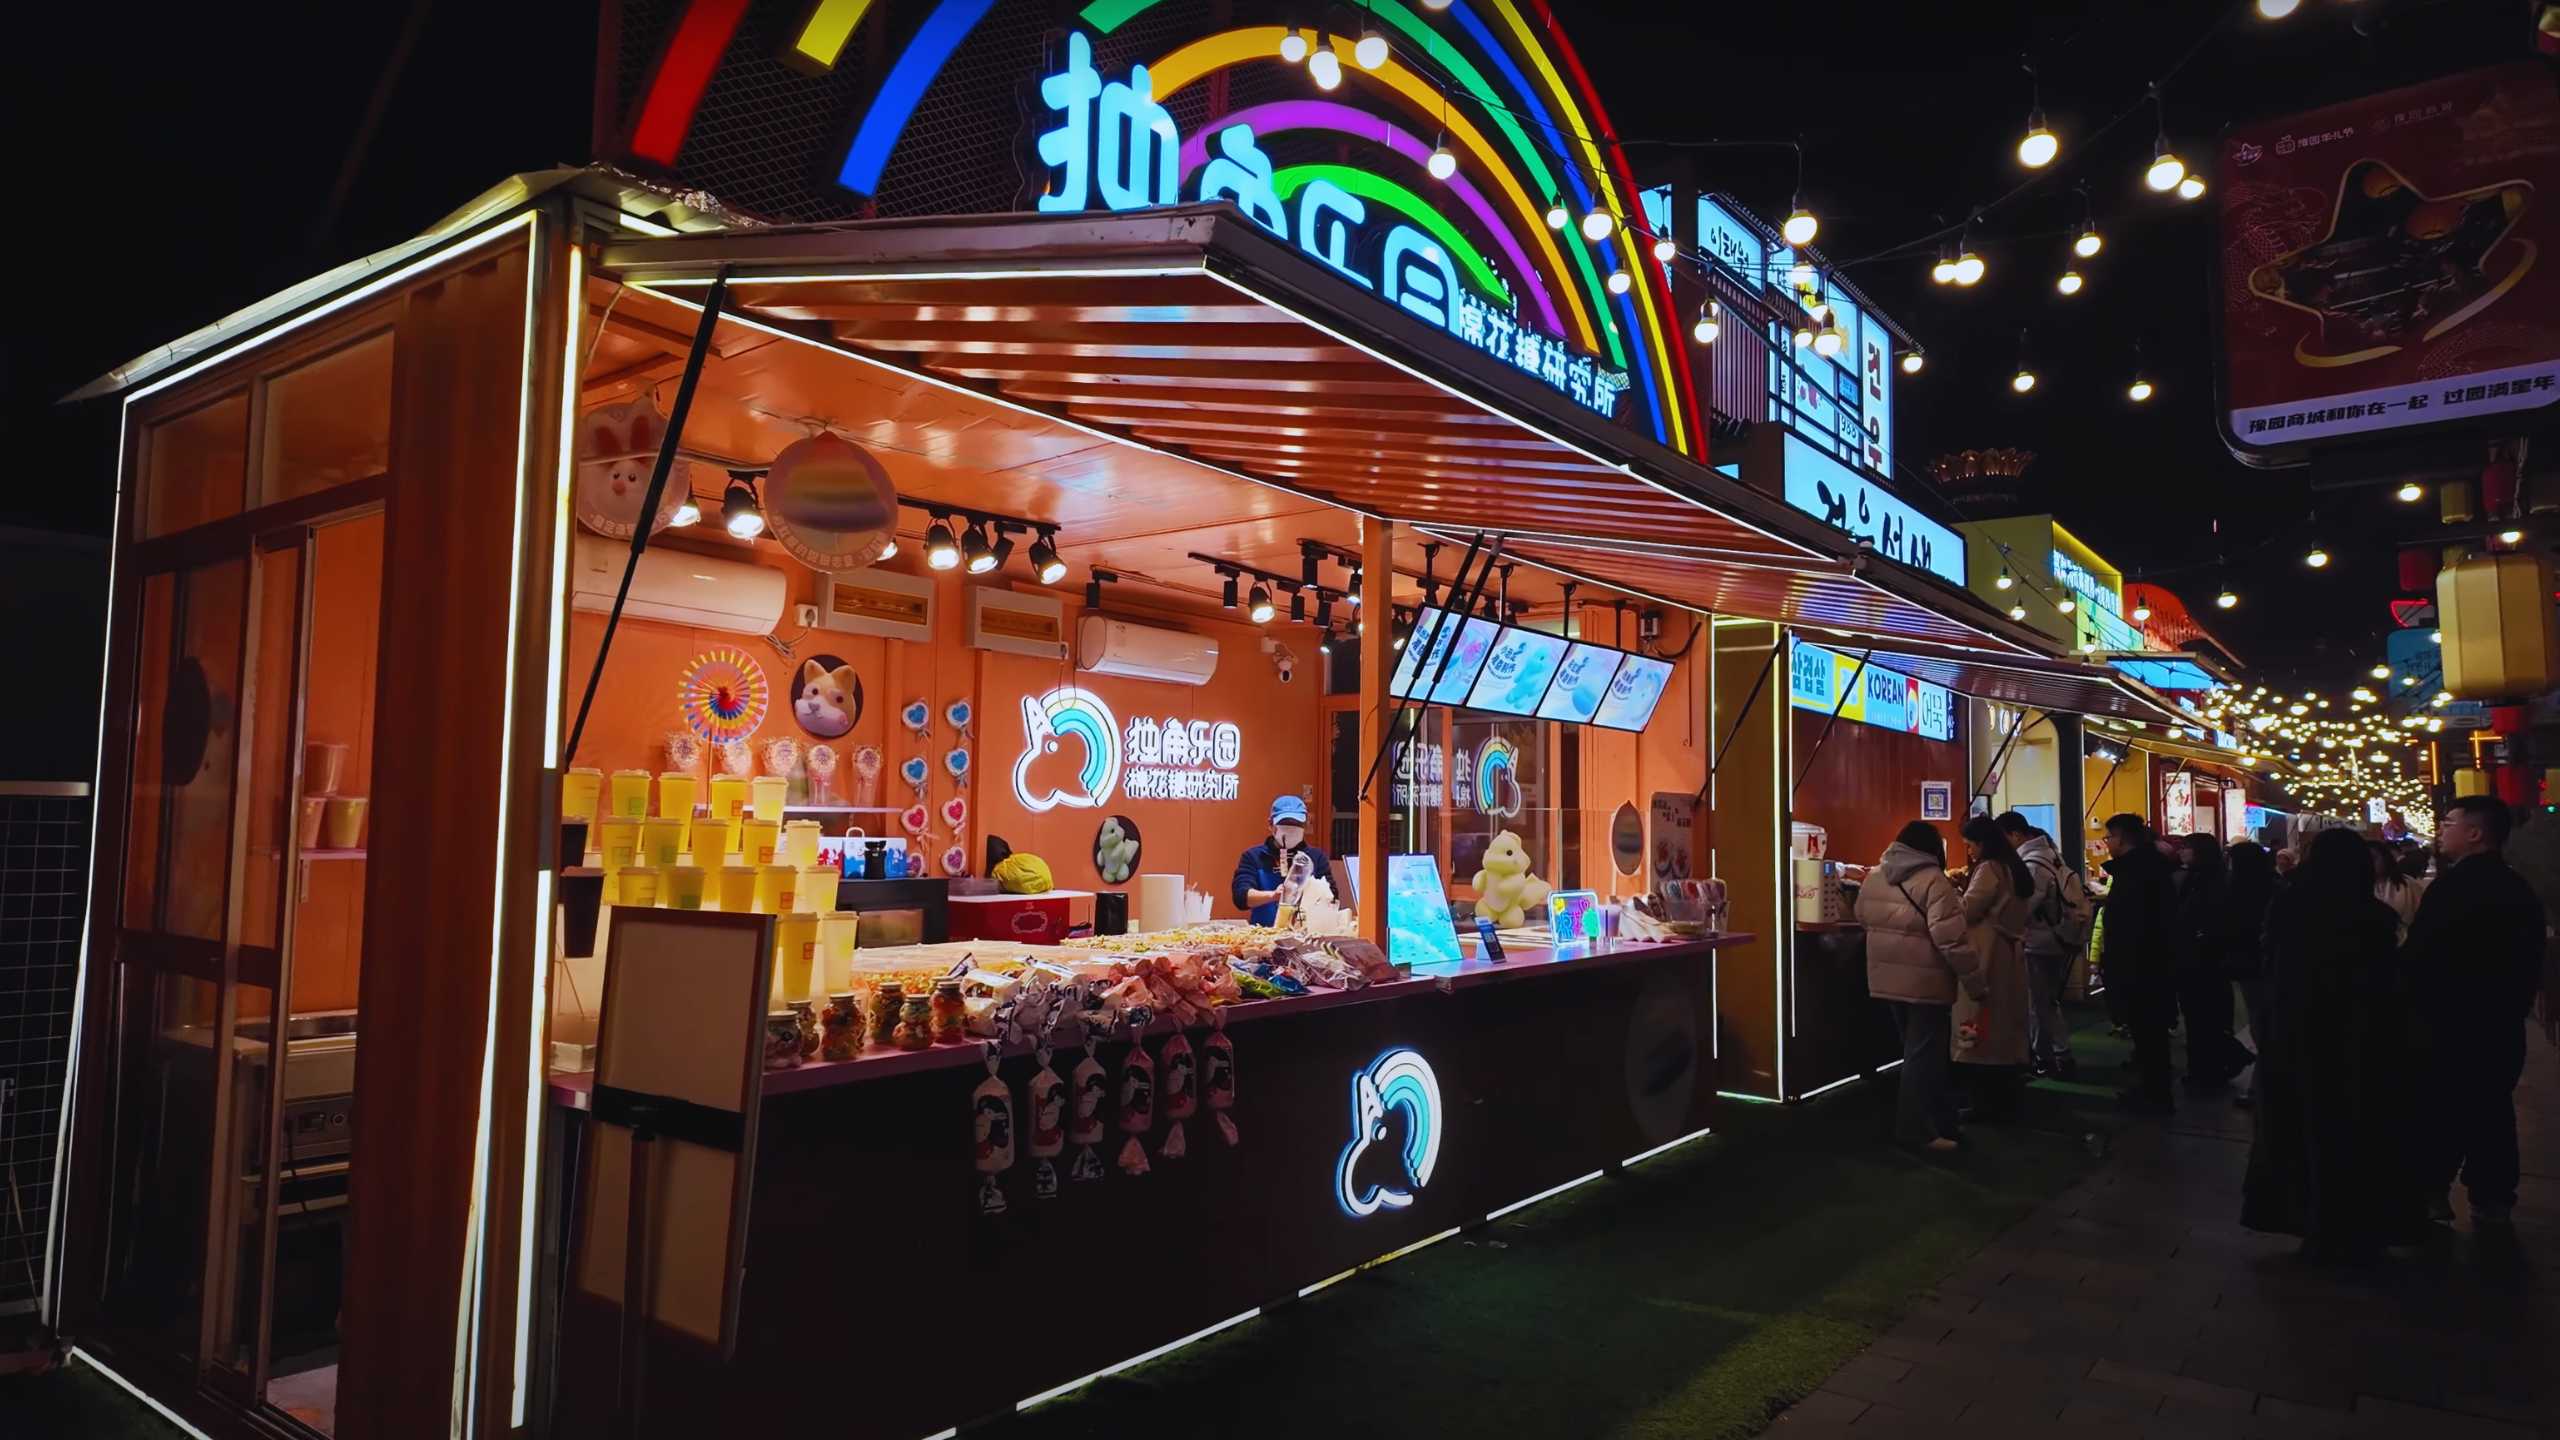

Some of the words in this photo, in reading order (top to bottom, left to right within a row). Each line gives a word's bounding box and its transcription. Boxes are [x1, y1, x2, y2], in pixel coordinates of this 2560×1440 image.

[2248, 394, 2429, 434] 豫园商城和你在一起
[1866, 671, 1905, 708] KOREAN
[1125, 716, 1241, 769] 独角乐园
[1124, 766, 1240, 801] 棉花糖研究所
